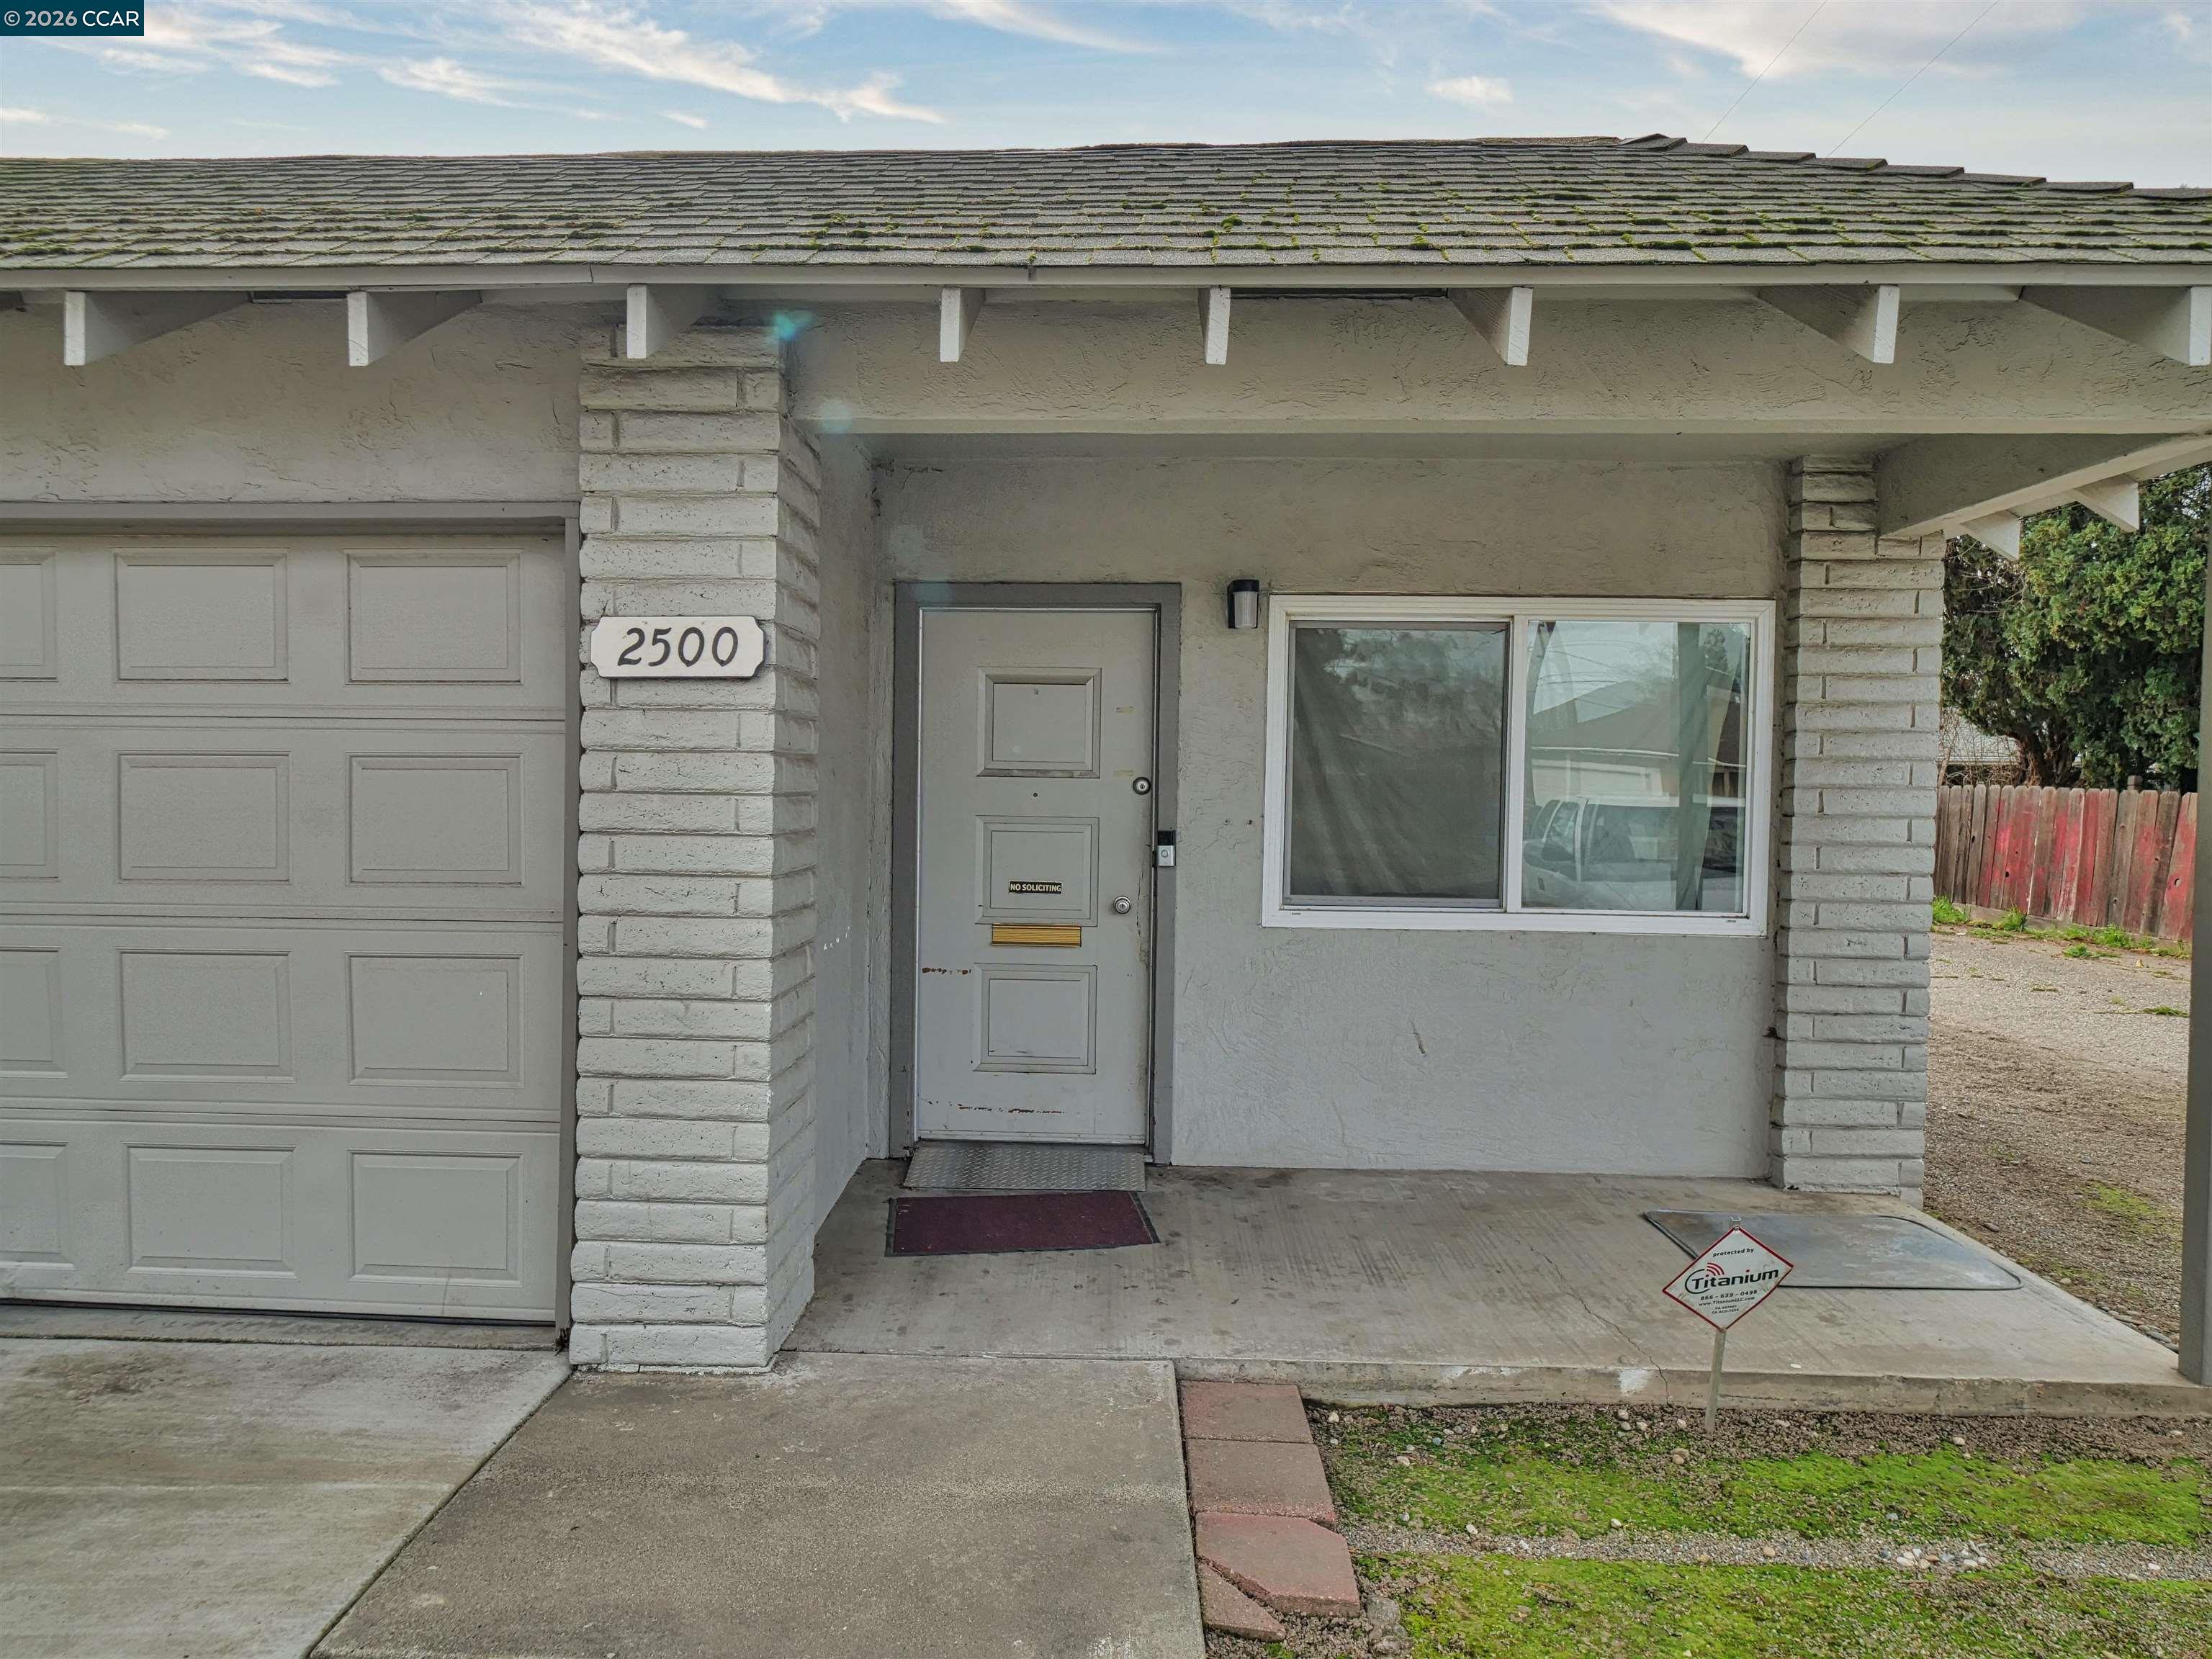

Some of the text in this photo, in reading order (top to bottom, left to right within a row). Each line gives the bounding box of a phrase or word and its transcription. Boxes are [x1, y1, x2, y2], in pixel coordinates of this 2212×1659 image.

[617, 626, 739, 667] 2500
[1022, 884, 1061, 892] SOLICITING
[1712, 1248, 1745, 1257] protected
[1691, 1269, 1779, 1290] Titanium
